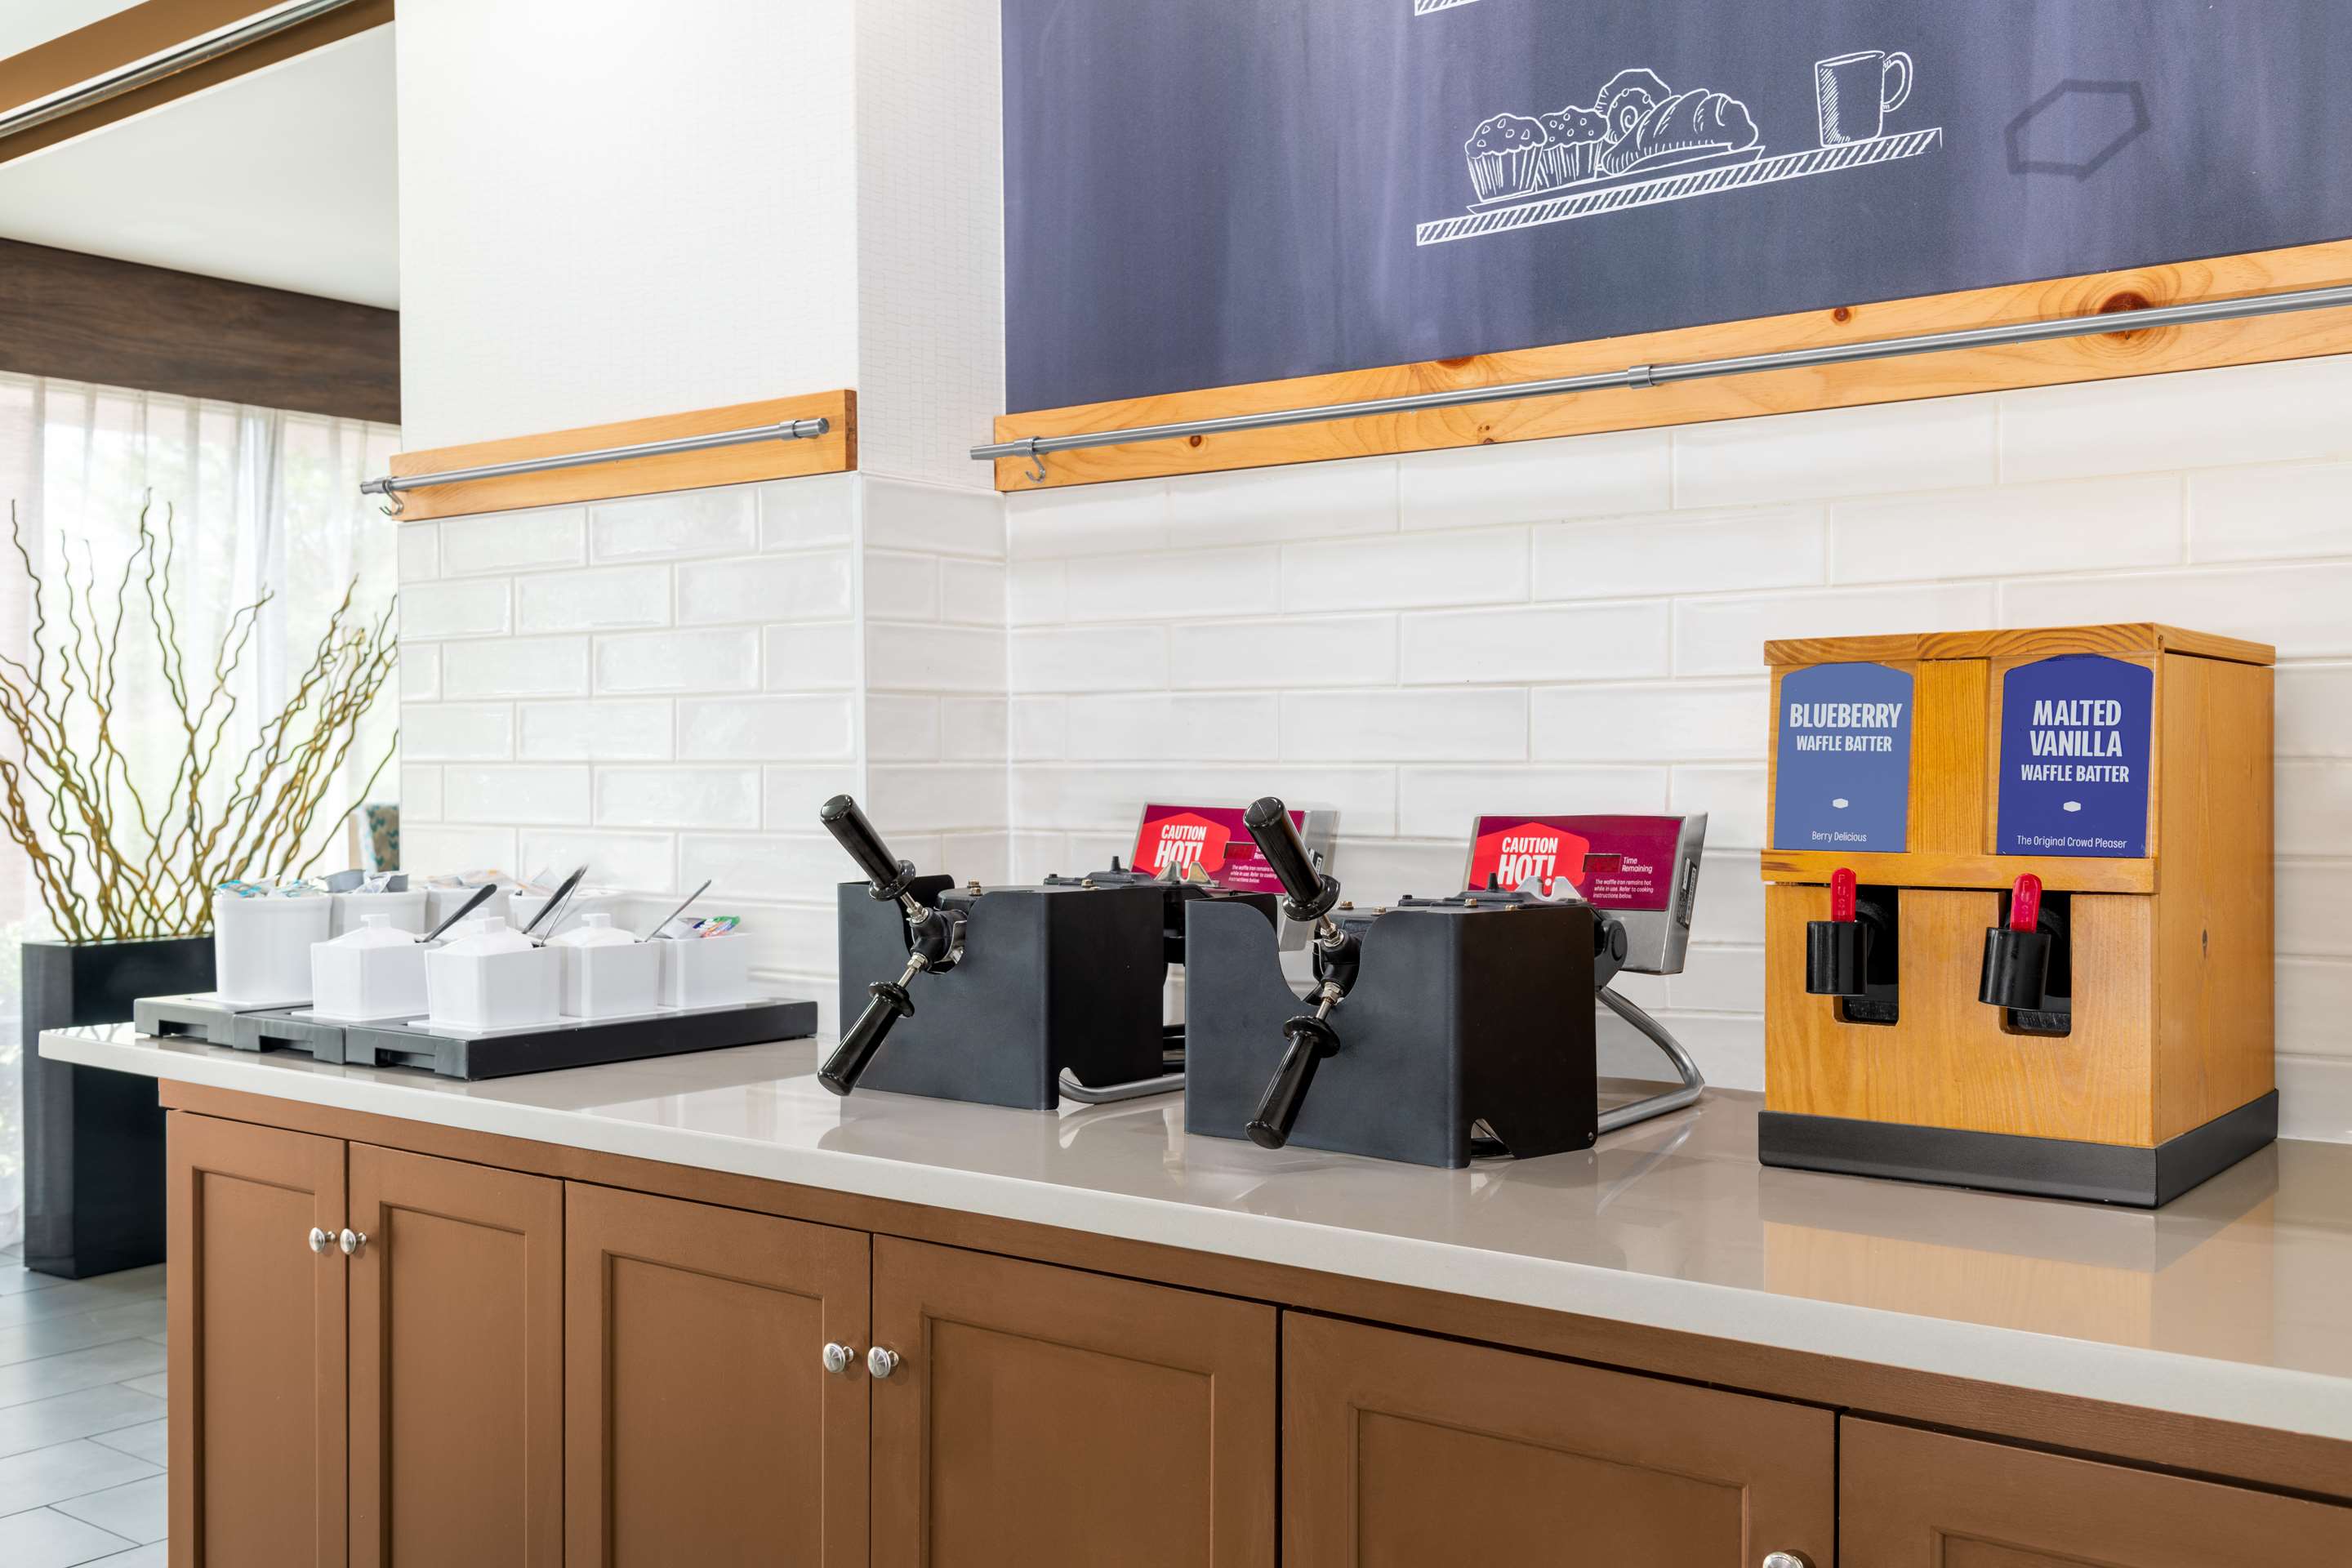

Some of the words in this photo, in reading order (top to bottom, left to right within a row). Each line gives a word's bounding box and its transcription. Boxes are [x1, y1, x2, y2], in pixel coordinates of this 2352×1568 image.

[1790, 703, 1903, 728] BLUEBERRY
[2032, 700, 2122, 726] MALTED
[1797, 735, 1842, 751] WAFFLE
[1845, 736, 1892, 751] BATTER
[2029, 730, 2123, 757] VANILLA
[2021, 764, 2073, 782] WAFFLE
[2076, 765, 2129, 782] BATTER
[1161, 825, 1207, 840] CAUTION
[1812, 831, 1833, 843] Berry
[1834, 831, 1868, 842] Delicious
[1502, 837, 1558, 853] CAUTION
[2017, 835, 2032, 845] The
[2034, 836, 2065, 848] Original
[2068, 837, 2093, 848] Crowd
[2096, 838, 2127, 849] Pleaser
[1154, 840, 1204, 869] HOT!
[1498, 854, 1556, 886] HOT!
[1622, 865, 1652, 874] Remaining
